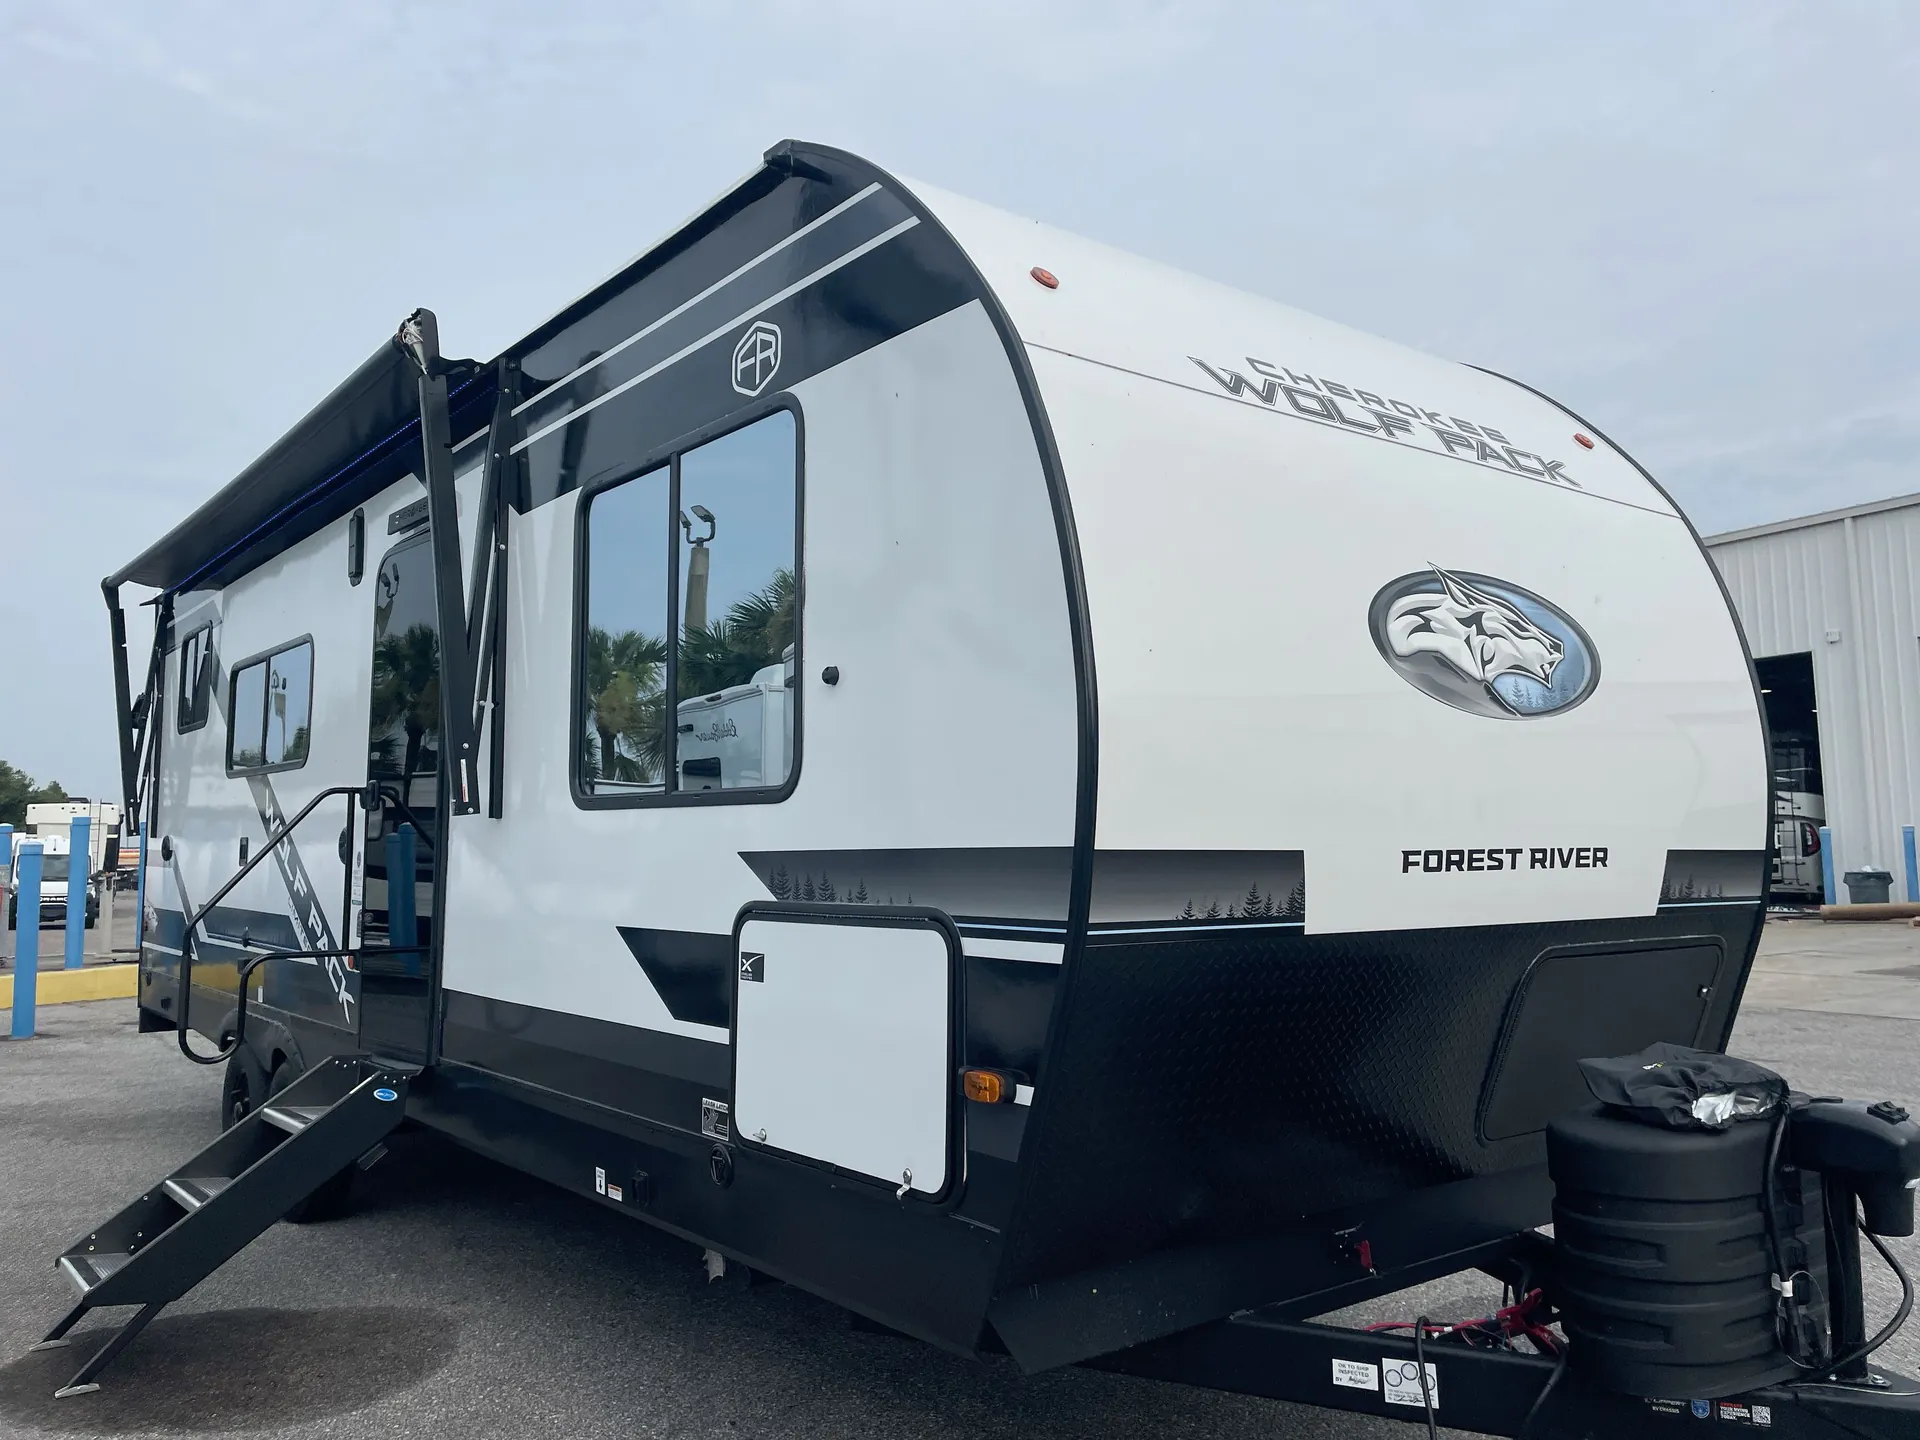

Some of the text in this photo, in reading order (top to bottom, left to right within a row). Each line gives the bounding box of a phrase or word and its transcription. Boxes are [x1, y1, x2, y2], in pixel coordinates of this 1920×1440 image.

[1186, 354, 1583, 489] WOLF PACK
[1245, 356, 1513, 447] CHEROKEE
[264, 787, 355, 1025] WOLF PACK
[1400, 847, 1608, 874] FOREST RIVER
[1338, 1369, 1370, 1377] INSPECTED
